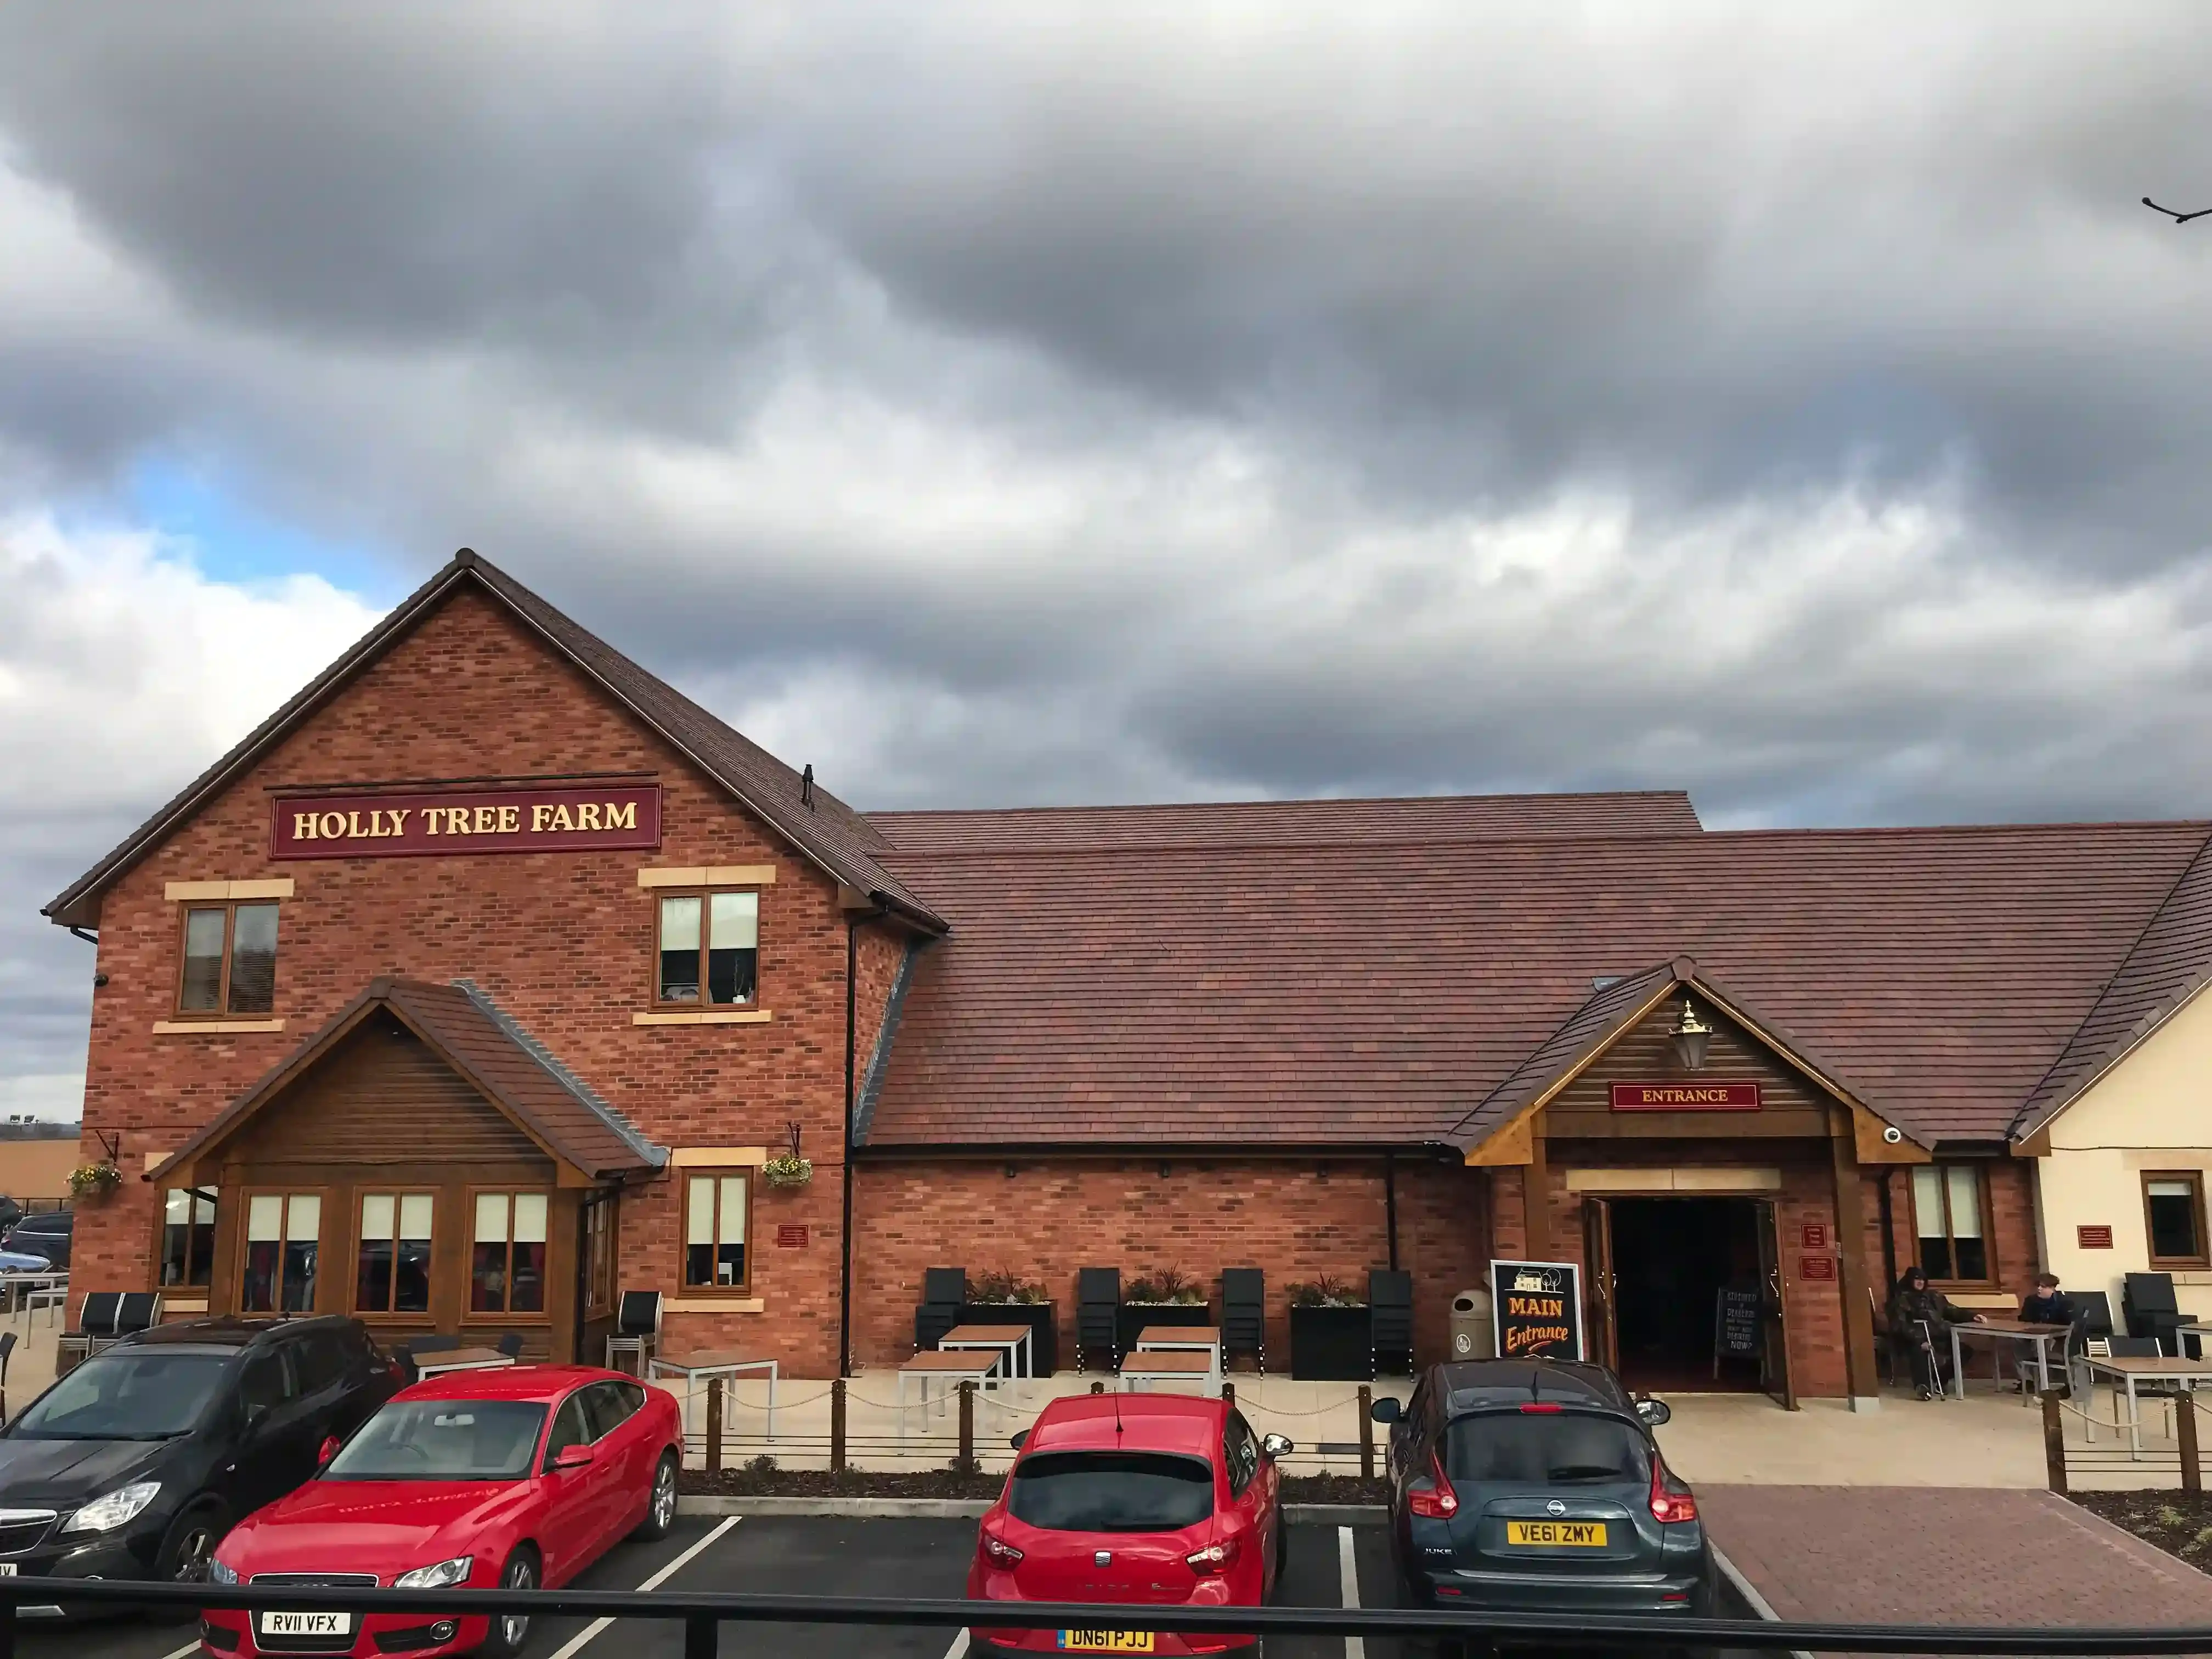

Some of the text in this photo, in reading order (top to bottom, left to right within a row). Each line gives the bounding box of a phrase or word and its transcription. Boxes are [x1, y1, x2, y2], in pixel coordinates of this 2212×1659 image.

[292, 802, 638, 840] HOLLY TREE FARM
[1642, 1090, 1728, 1102] ENTRANCE
[1509, 1297, 1563, 1318] MAIN
[1505, 1325, 1568, 1352] Entrance
[1519, 1525, 1594, 1542] VE61 ZMY
[273, 1615, 337, 1631] RV11 VFX
[1073, 1629, 1148, 1648] DN61 PJJ
